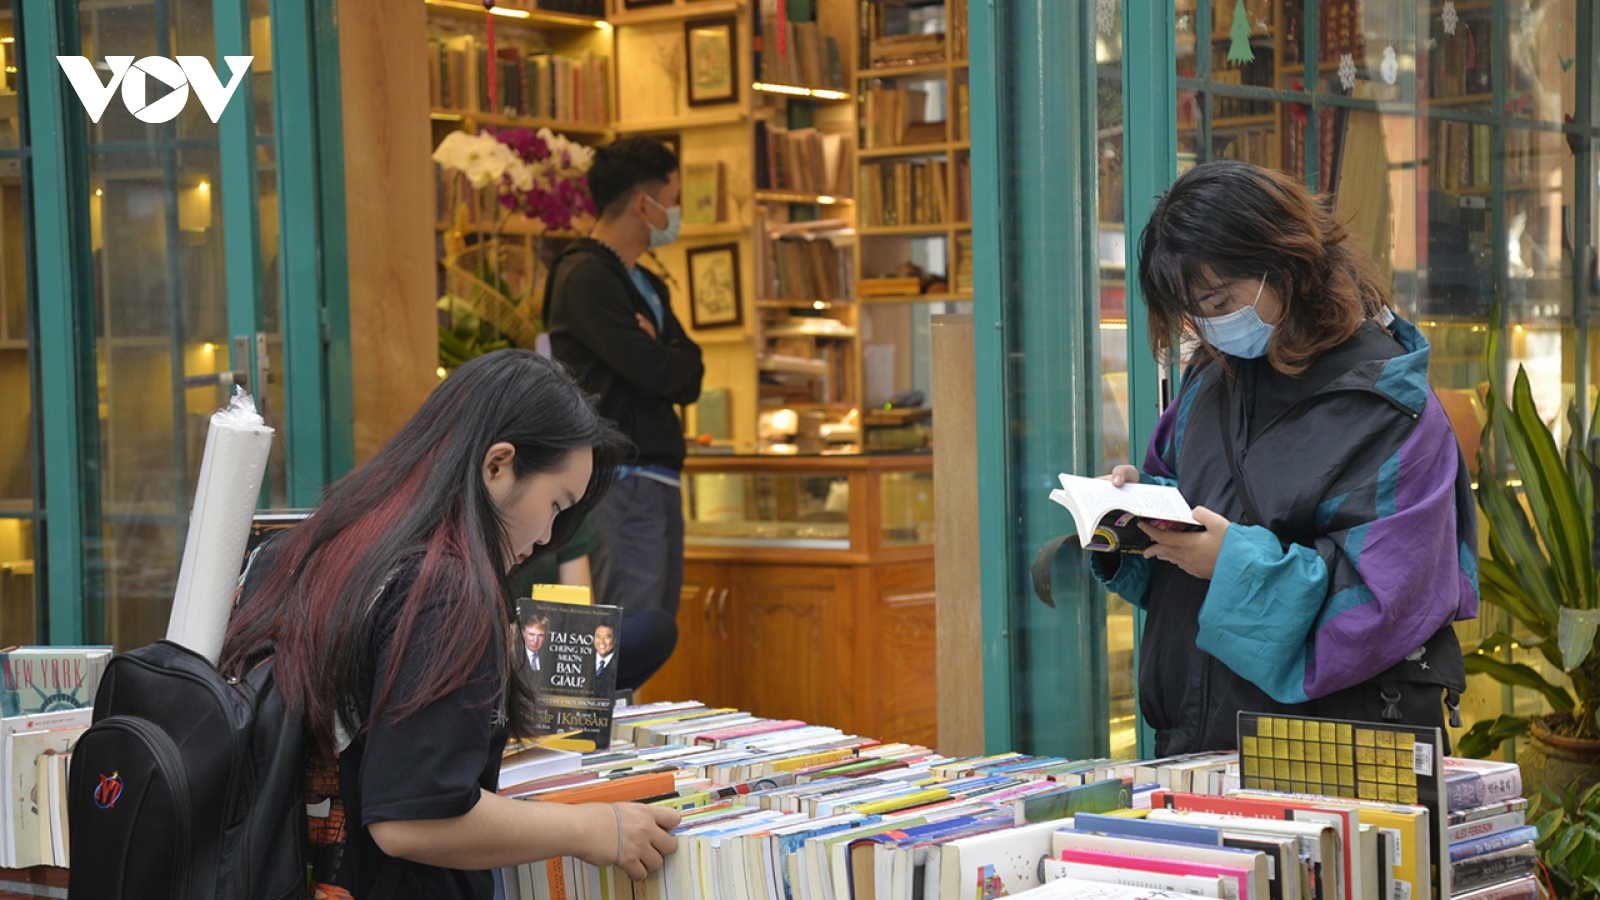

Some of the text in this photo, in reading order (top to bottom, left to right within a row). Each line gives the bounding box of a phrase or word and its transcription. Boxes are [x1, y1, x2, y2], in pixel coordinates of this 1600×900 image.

[569, 633, 594, 645] SAO
[3, 658, 83, 689] NEW YORK
[561, 712, 609, 727] KIYOSAKI
[1455, 822, 1494, 840] ALEX FERGUSON
